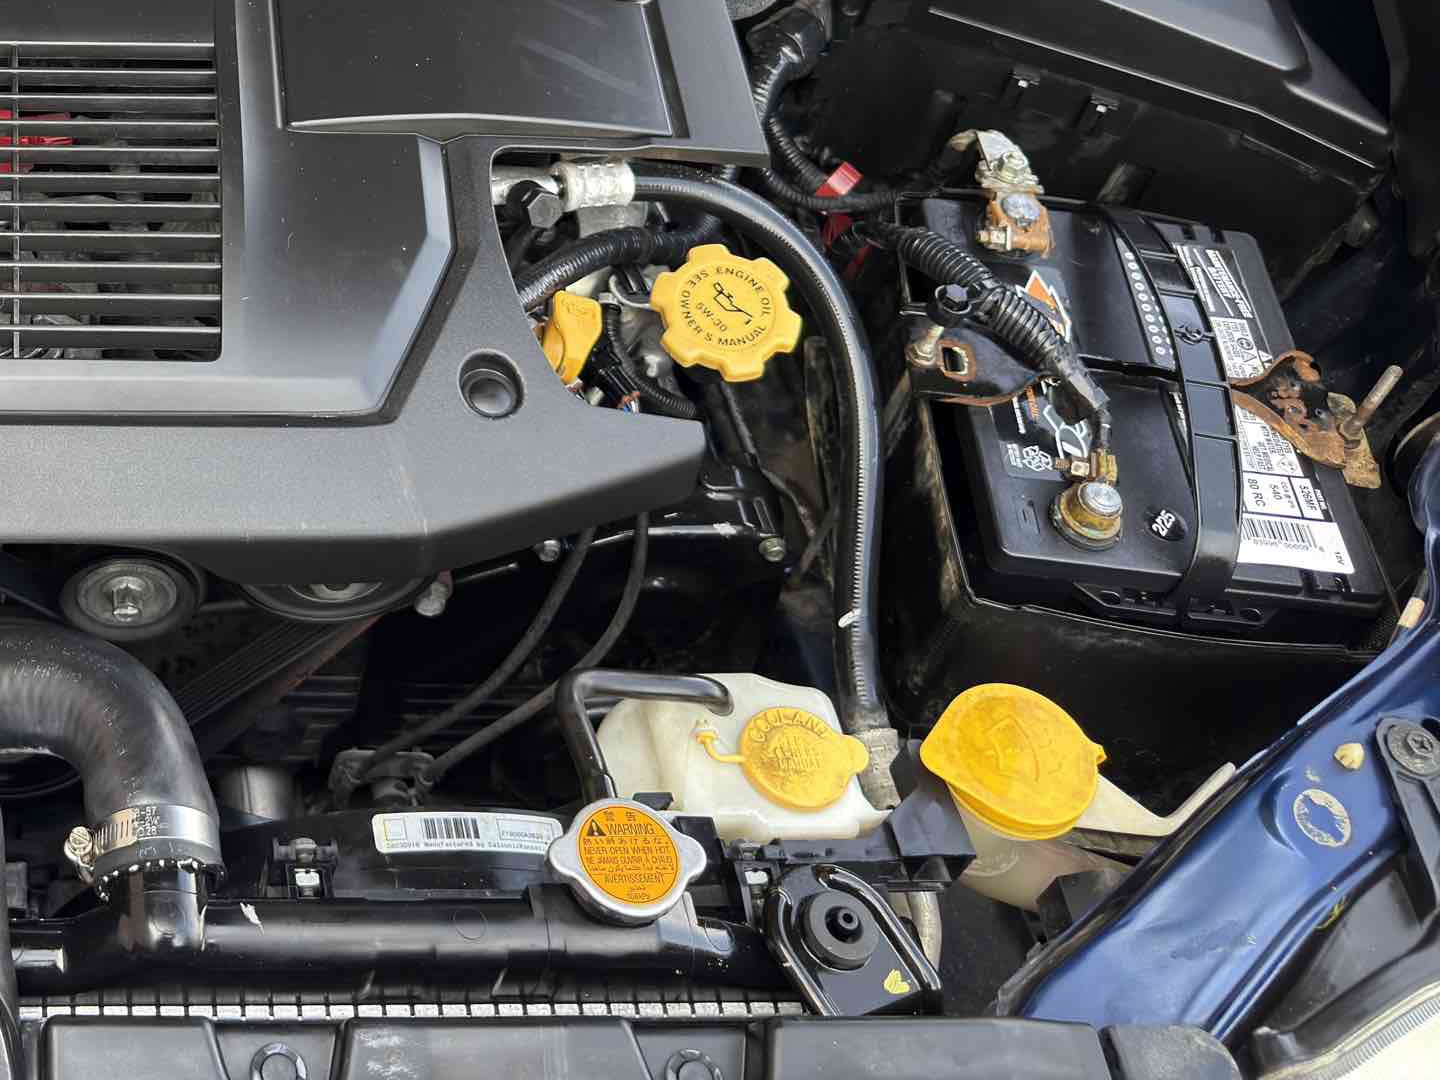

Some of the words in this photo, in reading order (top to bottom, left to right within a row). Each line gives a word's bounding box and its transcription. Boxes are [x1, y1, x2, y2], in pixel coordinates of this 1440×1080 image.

[716, 266, 766, 295] ENGINE
[760, 297, 772, 317] OIL
[687, 270, 709, 289] SEE
[717, 325, 766, 346] MANUAL
[1252, 491, 1266, 508] RC
[1299, 484, 1317, 512] 526MF
[1152, 510, 1176, 537] 2/25
[607, 823, 656, 835] WARNING
